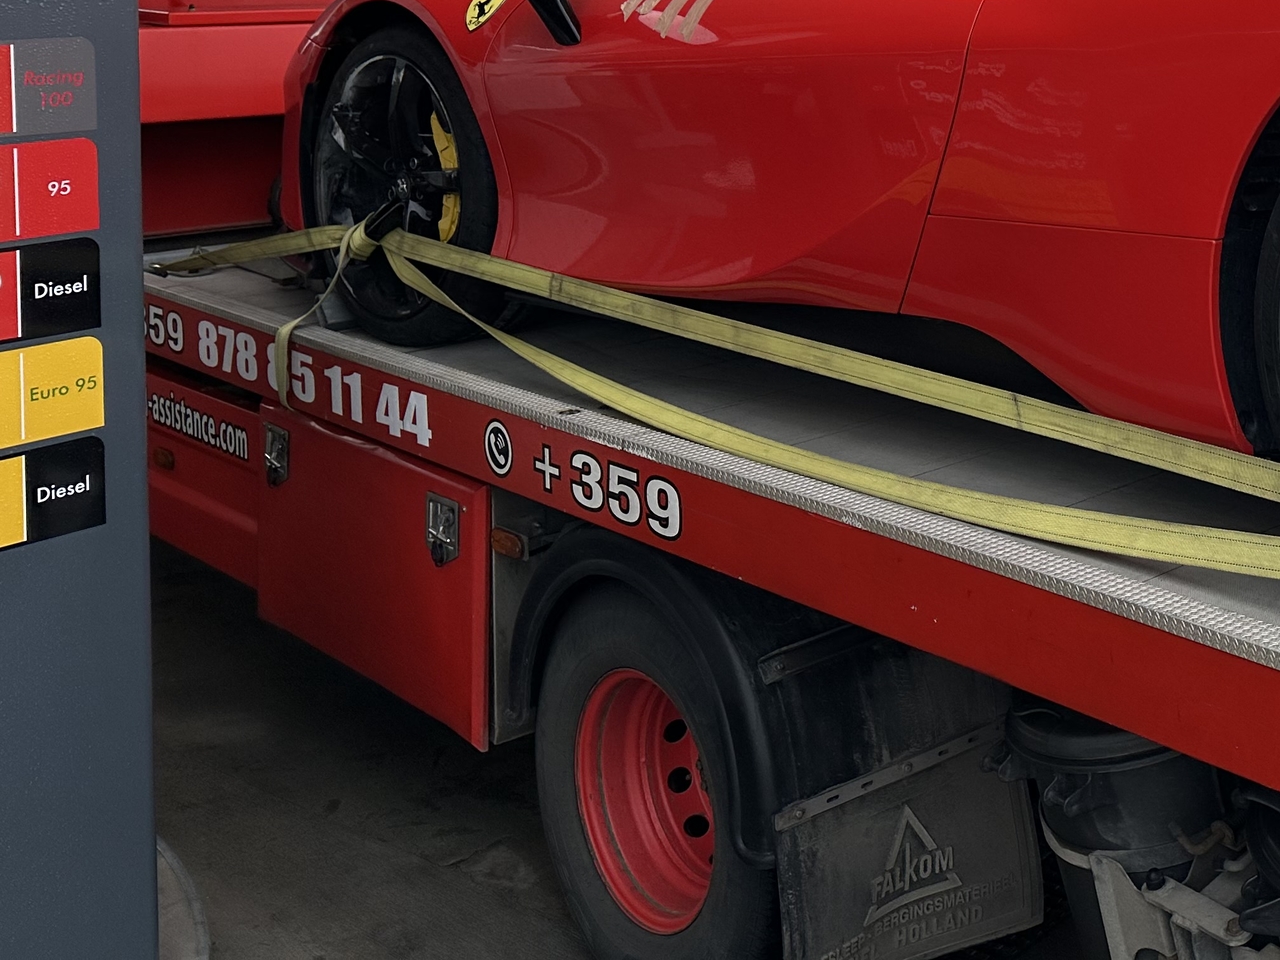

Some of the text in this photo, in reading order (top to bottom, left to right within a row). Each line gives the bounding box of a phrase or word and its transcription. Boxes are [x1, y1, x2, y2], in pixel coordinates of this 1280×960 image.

[23, 71, 85, 88] Racing
[40, 91, 74, 108] 100
[47, 180, 71, 197] 95
[34, 274, 88, 300] Diesel
[144, 303, 184, 353] 59
[198, 320, 258, 382] 878
[323, 364, 363, 424] 11
[375, 382, 433, 447] 44
[30, 375, 97, 402] Euro 95
[36, 474, 90, 504] Diesel
[895, 905, 984, 948] HOLLAND
